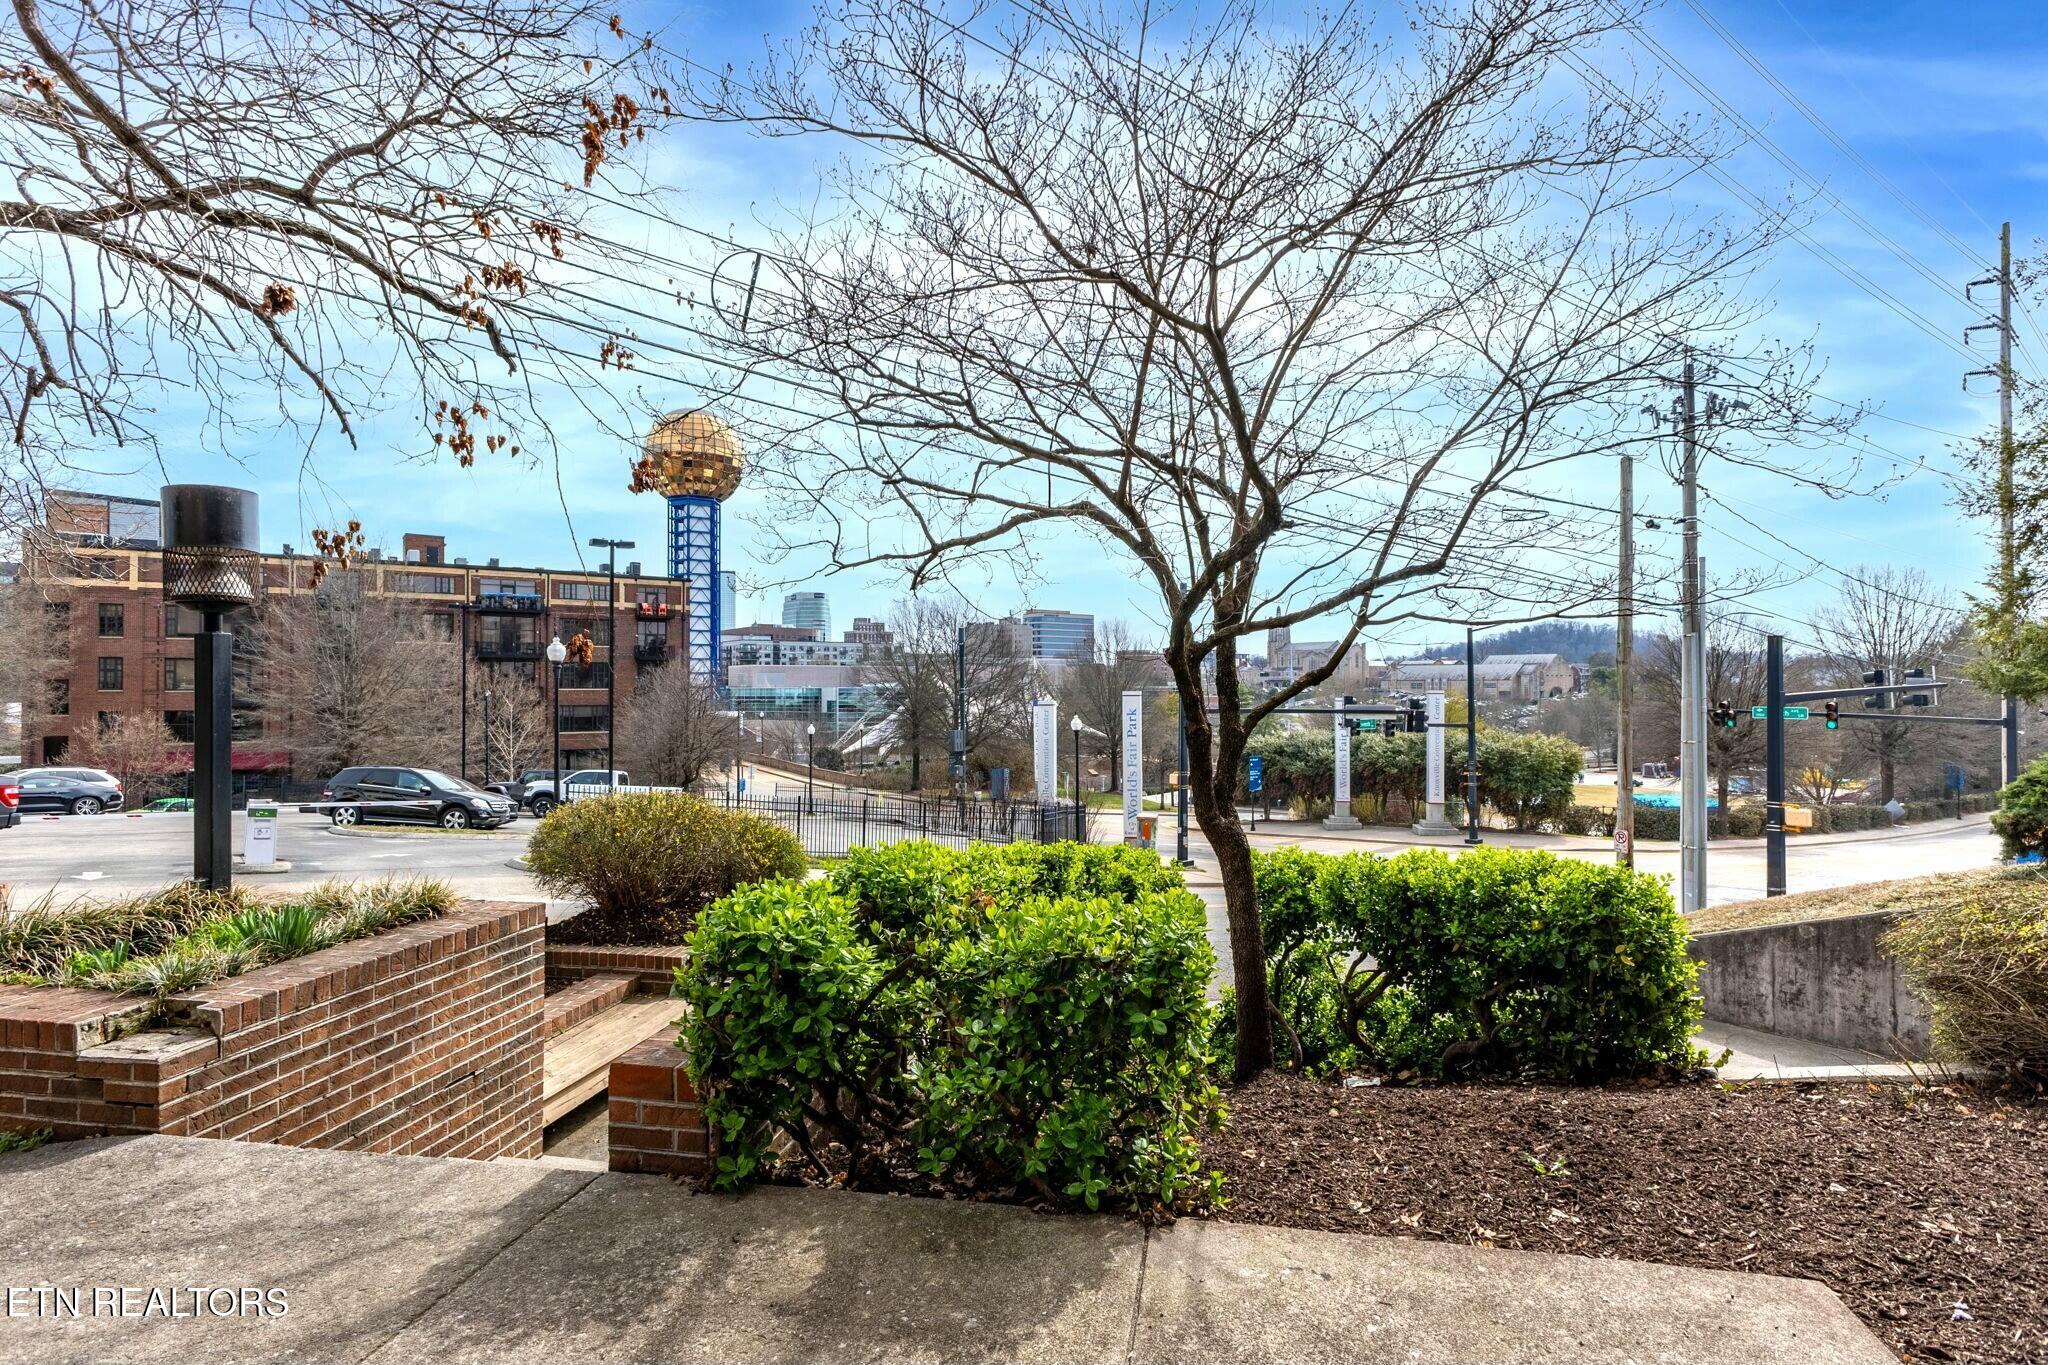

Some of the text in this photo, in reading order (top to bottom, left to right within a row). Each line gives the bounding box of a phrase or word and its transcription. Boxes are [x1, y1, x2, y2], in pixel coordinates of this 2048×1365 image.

[1042, 709, 1050, 736] Center
[1126, 708, 1137, 738] Park
[1127, 742, 1138, 767] Fair
[1338, 733, 1347, 752] Fair
[1042, 738, 1050, 784] Convention
[1127, 771, 1138, 820] World's
